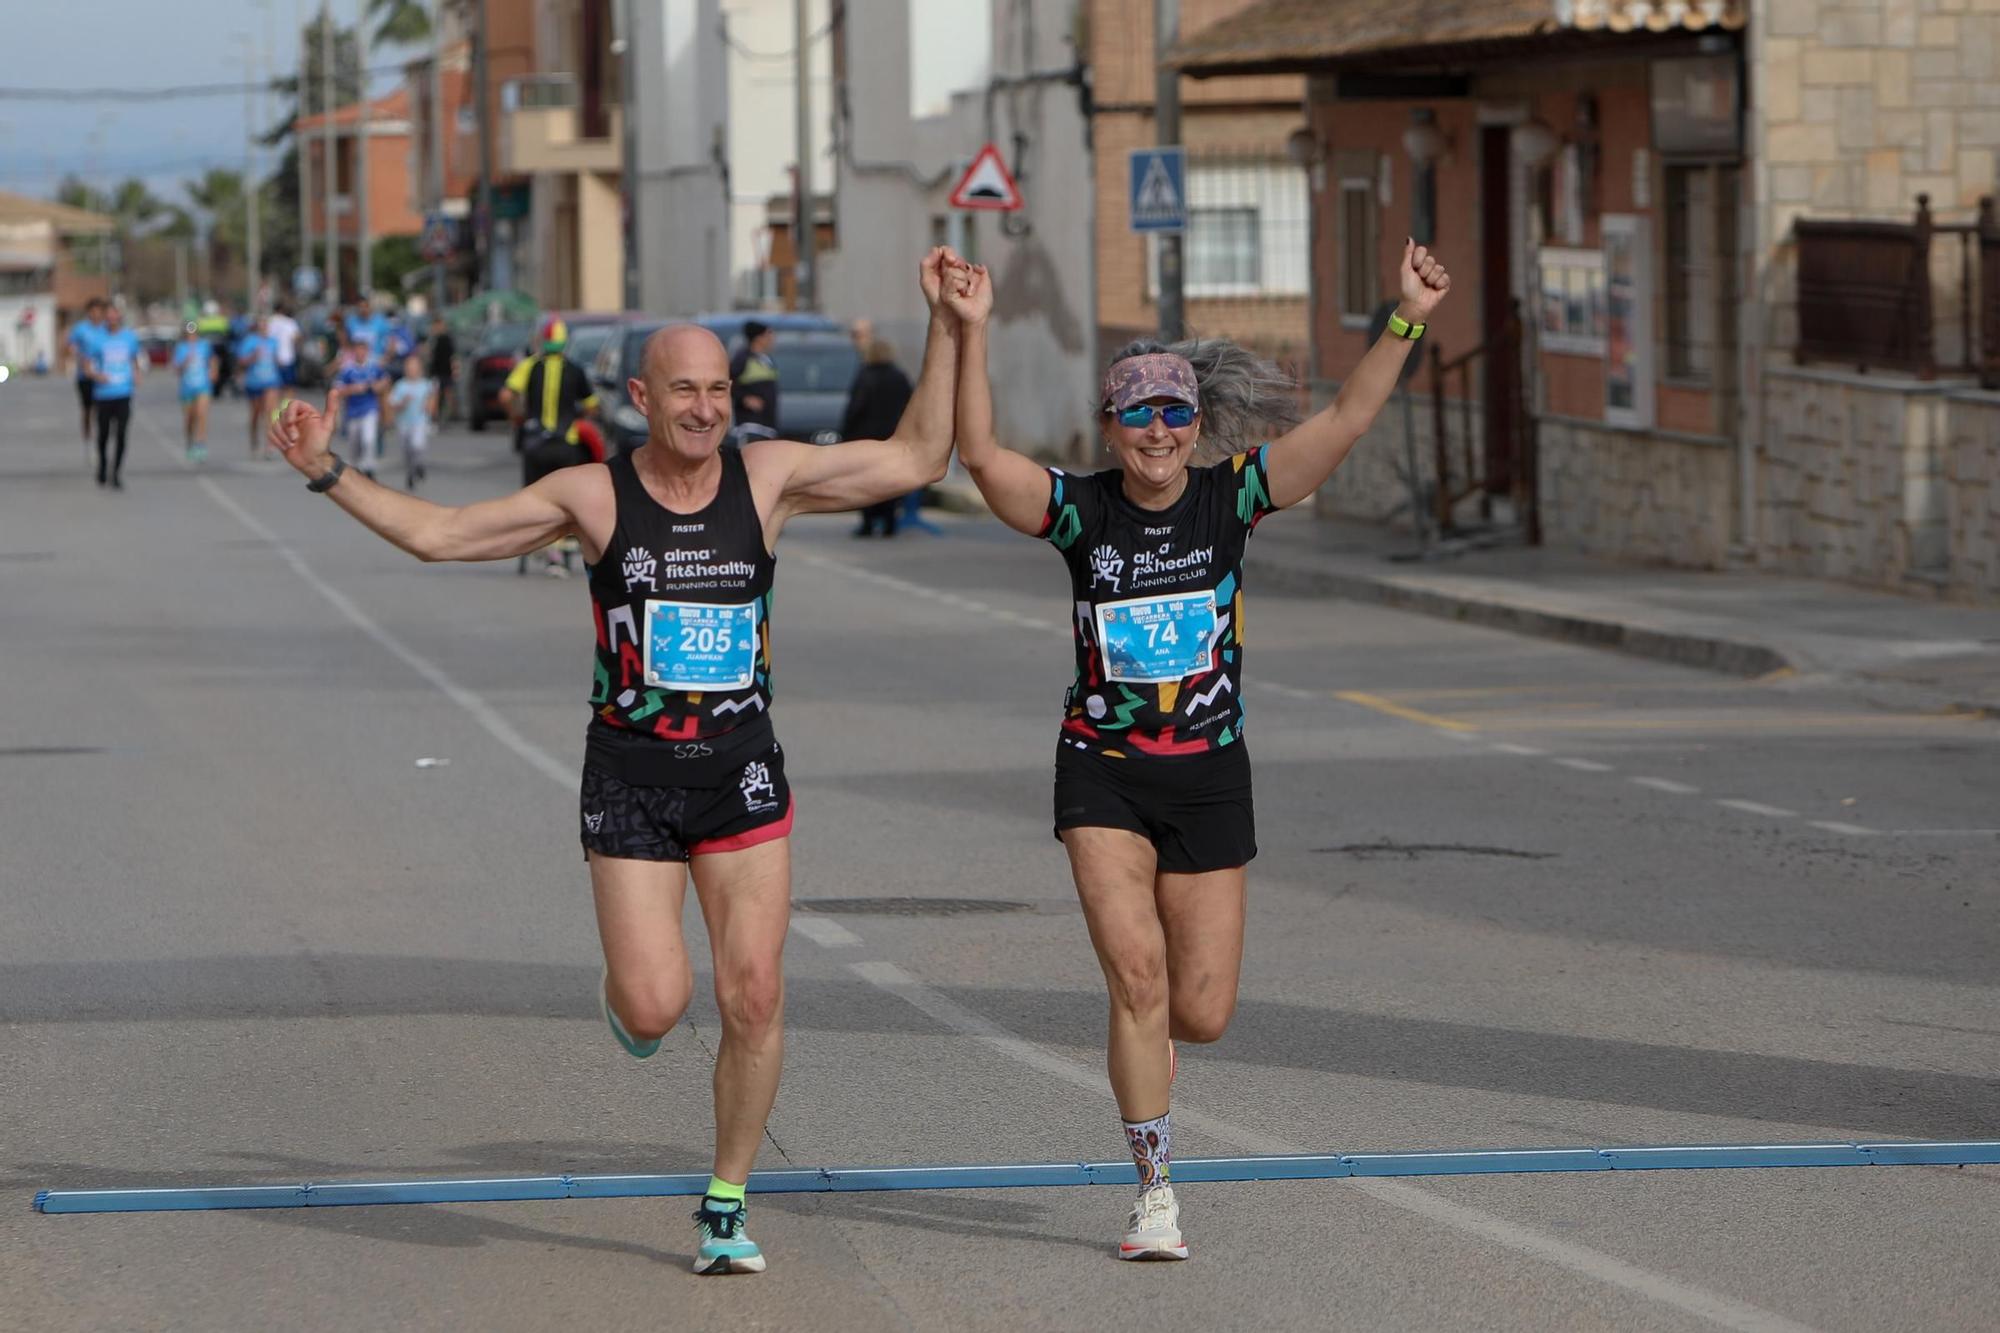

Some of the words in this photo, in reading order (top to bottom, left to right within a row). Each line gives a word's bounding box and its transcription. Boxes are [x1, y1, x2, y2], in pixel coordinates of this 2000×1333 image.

[672, 524, 705, 533] FASTER
[1144, 526, 1174, 535] FASTE
[664, 549, 710, 562] alma
[665, 561, 755, 579] fit&healthy
[666, 580, 717, 591] RUNNING
[720, 580, 746, 588] CLUB
[1129, 575, 1176, 590] UNNING
[1178, 568, 1207, 581] CLUB
[679, 627, 732, 653] 205
[1143, 620, 1179, 648] 74
